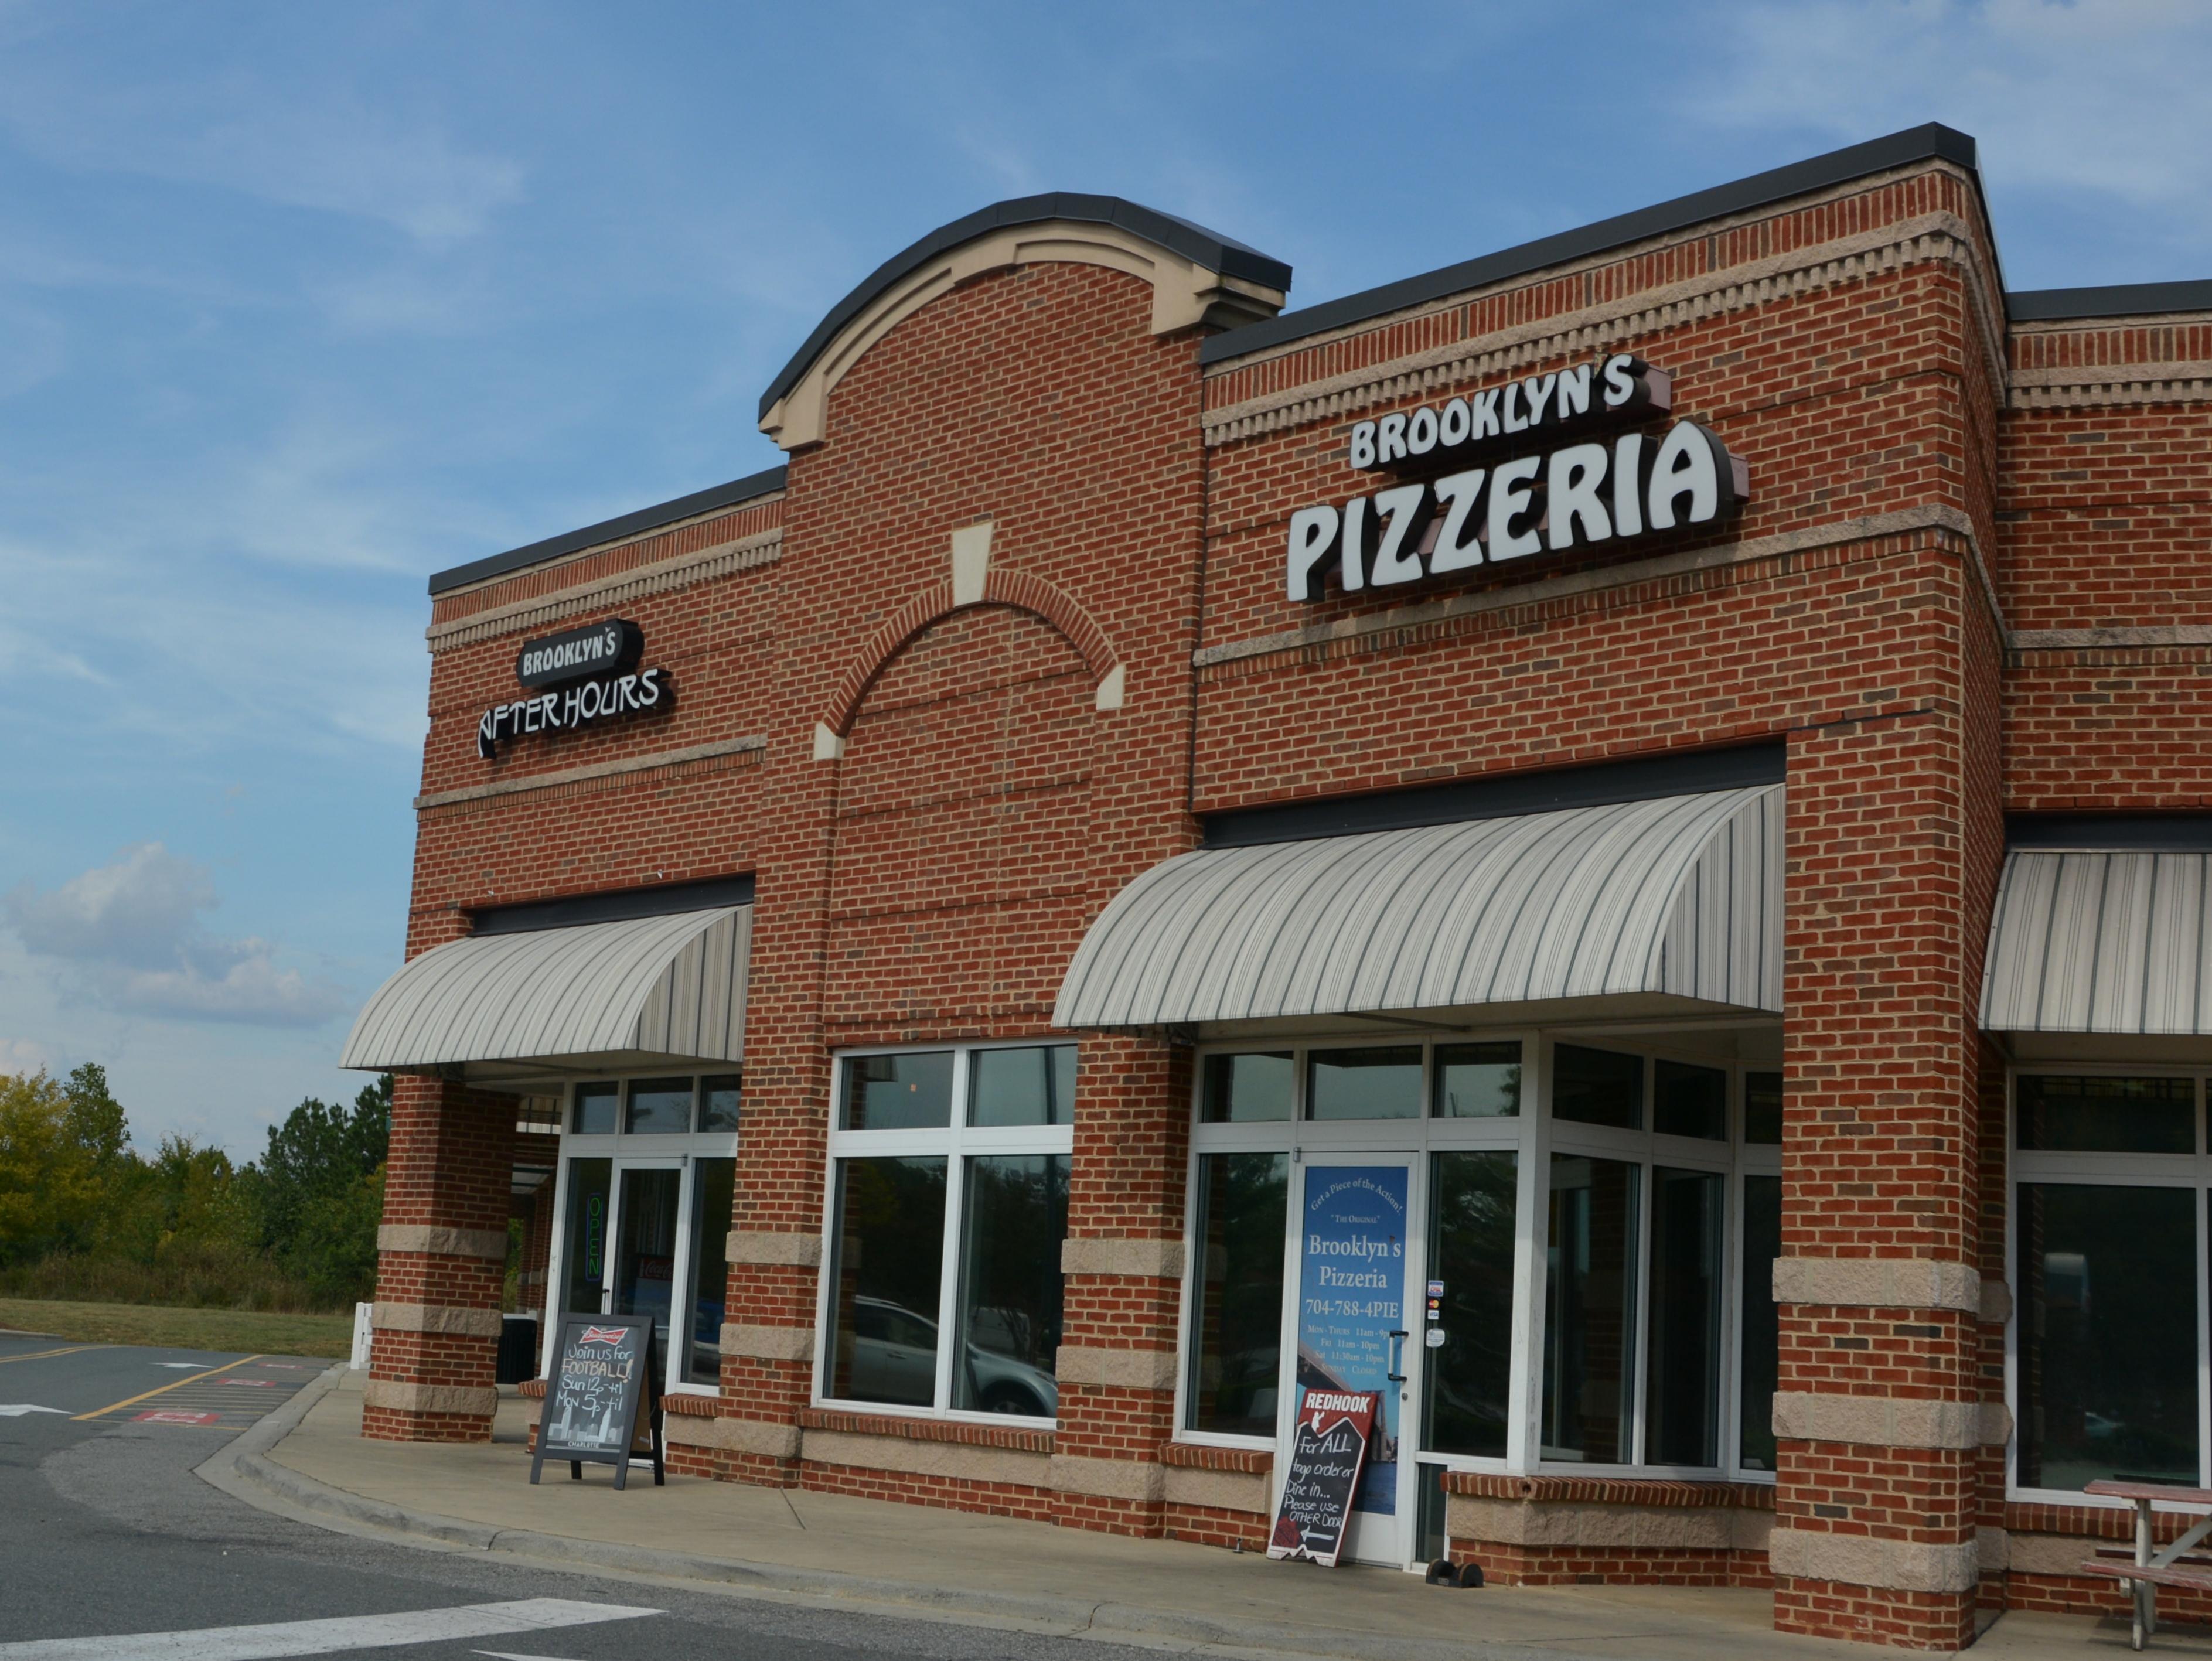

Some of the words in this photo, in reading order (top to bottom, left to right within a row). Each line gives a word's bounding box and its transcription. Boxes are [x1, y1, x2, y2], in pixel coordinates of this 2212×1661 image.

[1350, 353, 1634, 469] BROOKLYN'S
[1287, 419, 1717, 602] PIZZERIA
[523, 626, 616, 676] BROOKLYN'S
[478, 692, 561, 758] AFTER
[564, 668, 660, 728] HOURS
[1311, 1195, 1325, 1211] Get
[1330, 1181, 1351, 1195] Piece
[1352, 1177, 1363, 1188] of
[1362, 1179, 1375, 1191] the
[1375, 1185, 1403, 1214] Action!
[589, 1197, 601, 1275] OPEN
[1308, 1234, 1402, 1263] Brooklyn's
[1319, 1266, 1388, 1288] Pizzeria
[1306, 1298, 1399, 1318] 704-788-4PIE
[1356, 1328, 1374, 1337] 11am
[568, 1343, 594, 1360] Join
[597, 1349, 611, 1360] us
[1338, 1339, 1355, 1349] 11am
[1361, 1341, 1379, 1352] 10pm
[1332, 1351, 1360, 1361] 11:30am
[1365, 1354, 1385, 1365] 10pm
[561, 1374, 585, 1390] Sun
[1306, 1393, 1371, 1413] REDHOOK
[568, 1441, 599, 1449] CHARLOTTE
[1299, 1436, 1320, 1455] For
[1320, 1433, 1351, 1454] ALL
[1314, 1462, 1342, 1477] order
[1342, 1468, 1354, 1478] or
[1286, 1479, 1306, 1495] Dine
[1283, 1495, 1317, 1511] Please
[1320, 1501, 1340, 1513] use
[1289, 1510, 1321, 1525] OTHER
